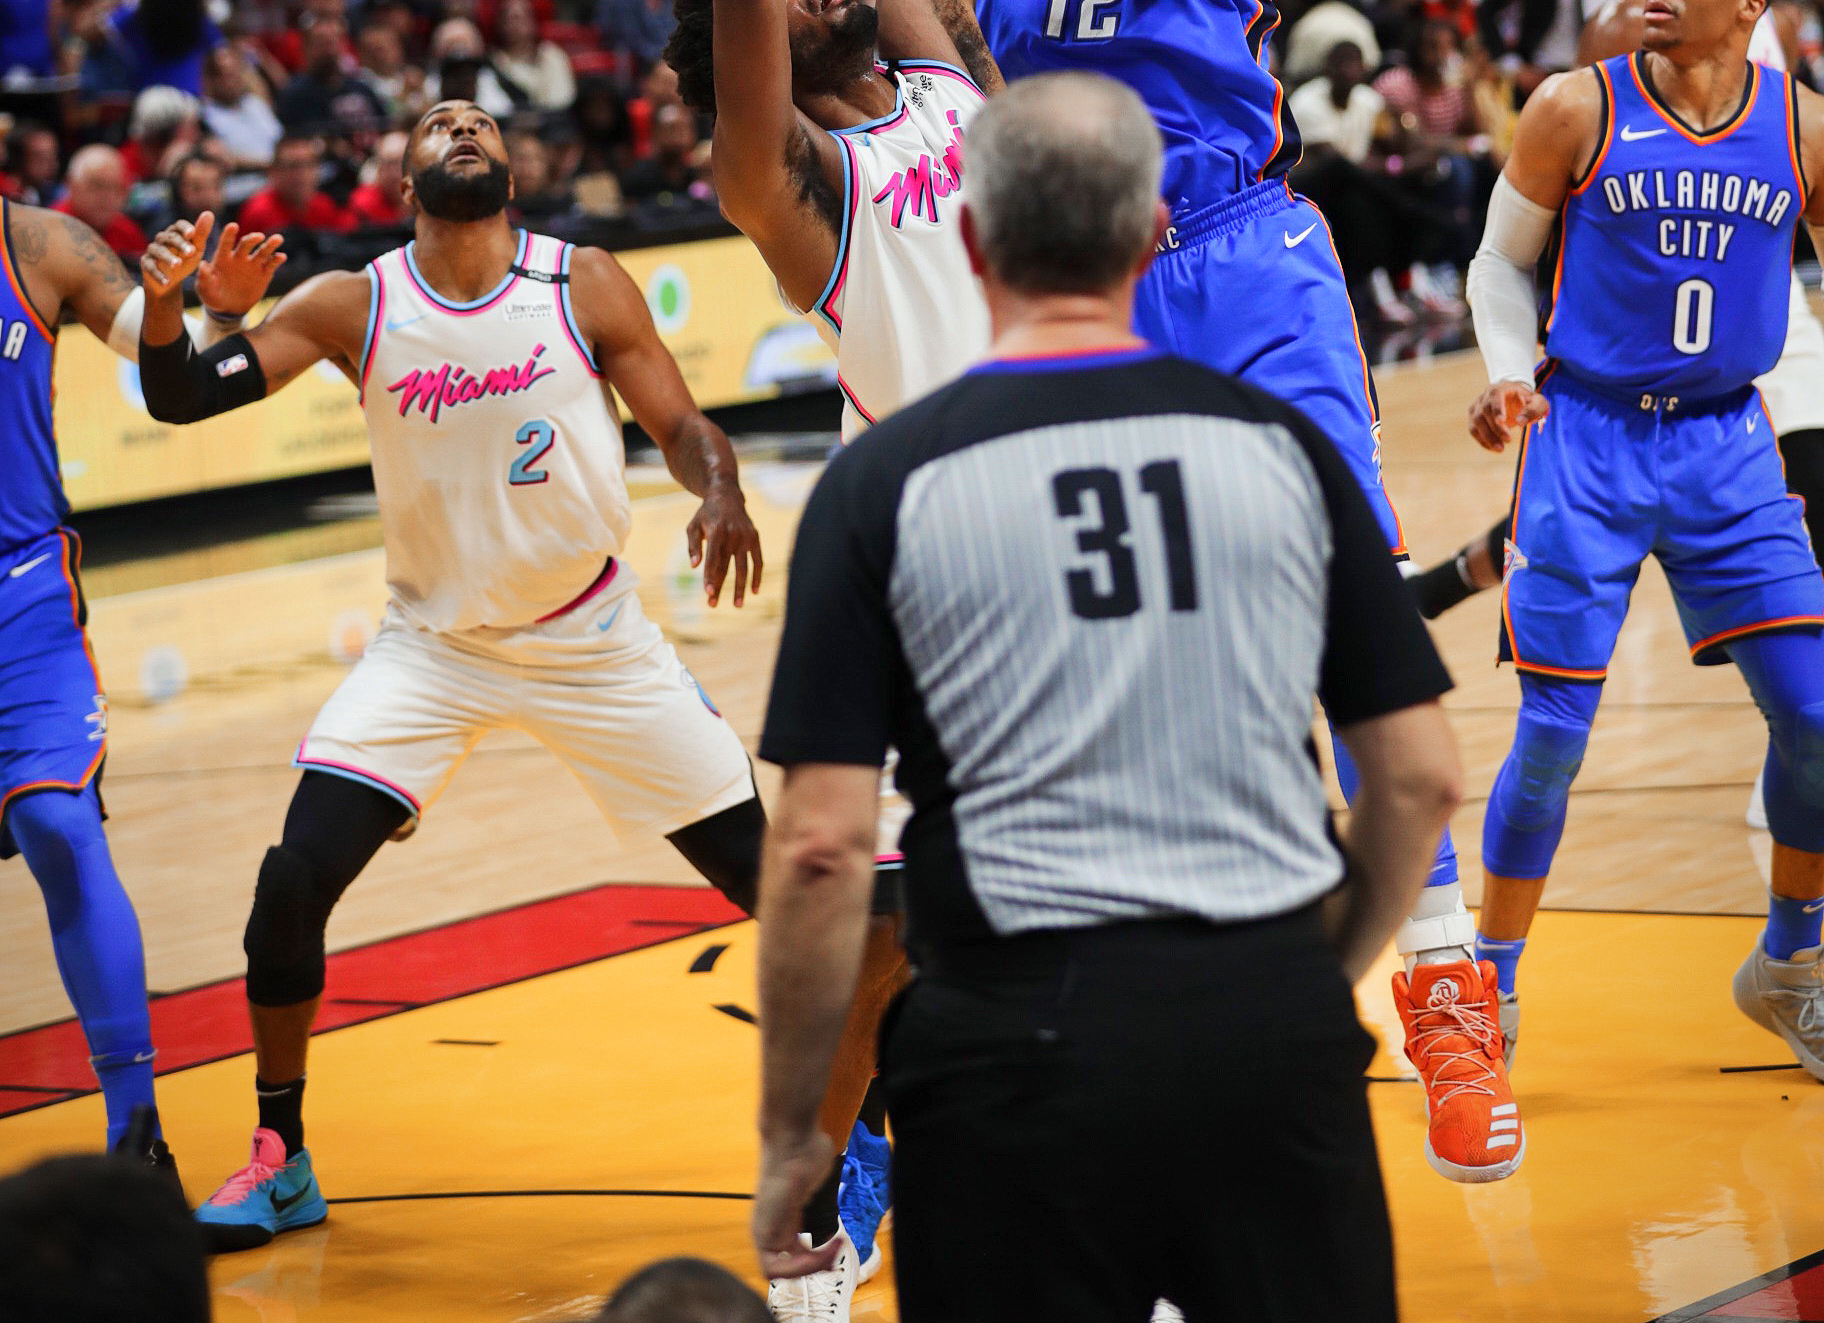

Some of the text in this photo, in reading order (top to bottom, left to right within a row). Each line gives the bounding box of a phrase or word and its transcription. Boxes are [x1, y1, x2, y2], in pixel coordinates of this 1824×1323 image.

[1602, 170, 1793, 227] OKLAHOMA
[1660, 219, 1735, 261] CITY
[1673, 279, 1714, 355] 0
[387, 342, 557, 425] Miami
[508, 419, 555, 486] 2
[1052, 458, 1198, 620] 31
